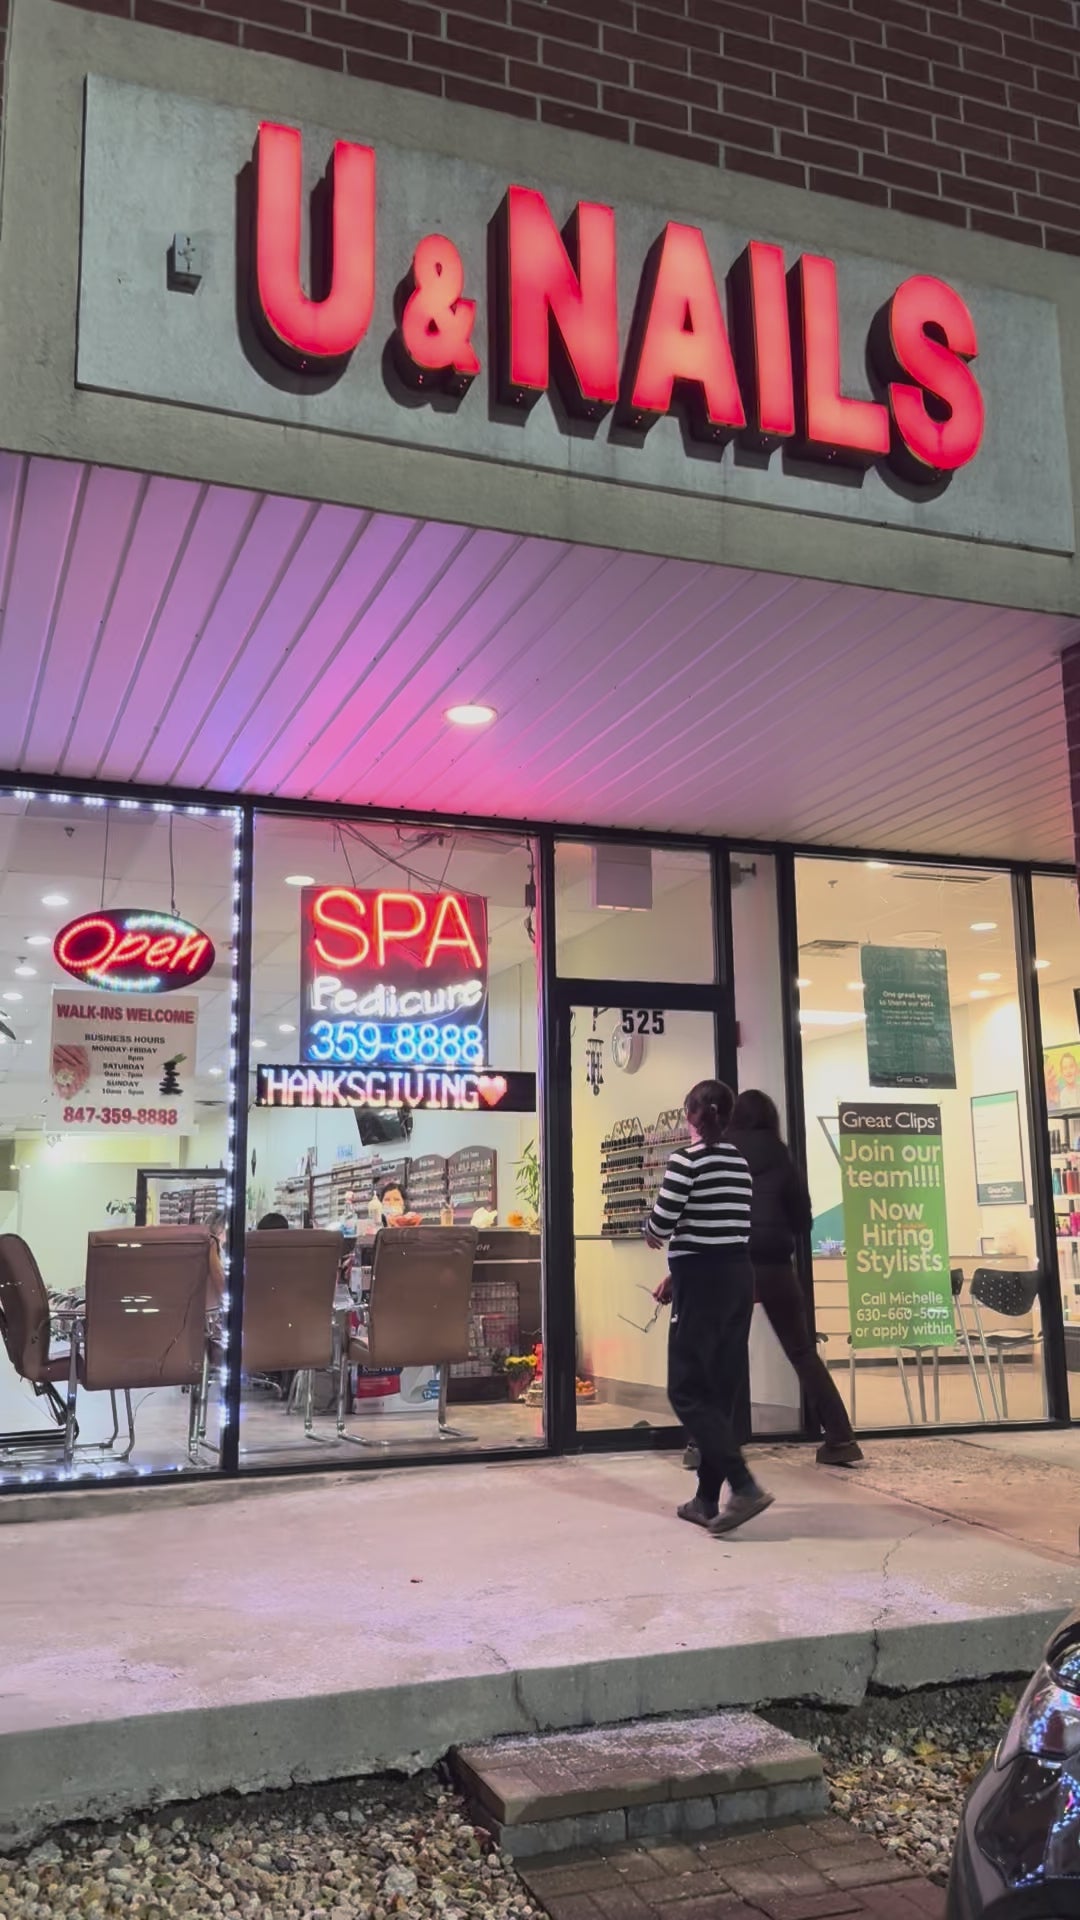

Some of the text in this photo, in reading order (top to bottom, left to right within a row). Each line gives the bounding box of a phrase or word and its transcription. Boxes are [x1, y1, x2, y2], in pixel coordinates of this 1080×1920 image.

[256, 121, 375, 358] U
[508, 184, 985, 470] NAILS
[314, 889, 483, 968] SPA
[58, 919, 209, 975] Open
[309, 976, 483, 1017] Pedicure
[57, 1004, 194, 1024] WALK-INS WELCOME
[621, 1010, 665, 1034] 525
[84, 1033, 166, 1044] BUSINESS HOURS
[309, 1021, 483, 1063] 359-8888
[102, 1062, 145, 1071] SATURDAY
[106, 1080, 140, 1088] SUNDAY
[63, 1106, 178, 1125] 847-359-8888
[842, 1111, 936, 1133] Great Clips
[843, 1139, 941, 1163] Join our
[847, 1164, 940, 1188] team!!!!
[869, 1197, 925, 1221] Now
[862, 1222, 935, 1253] Hiring
[861, 1291, 944, 1305] Call Michelle
[855, 1320, 953, 1340] or apply within
